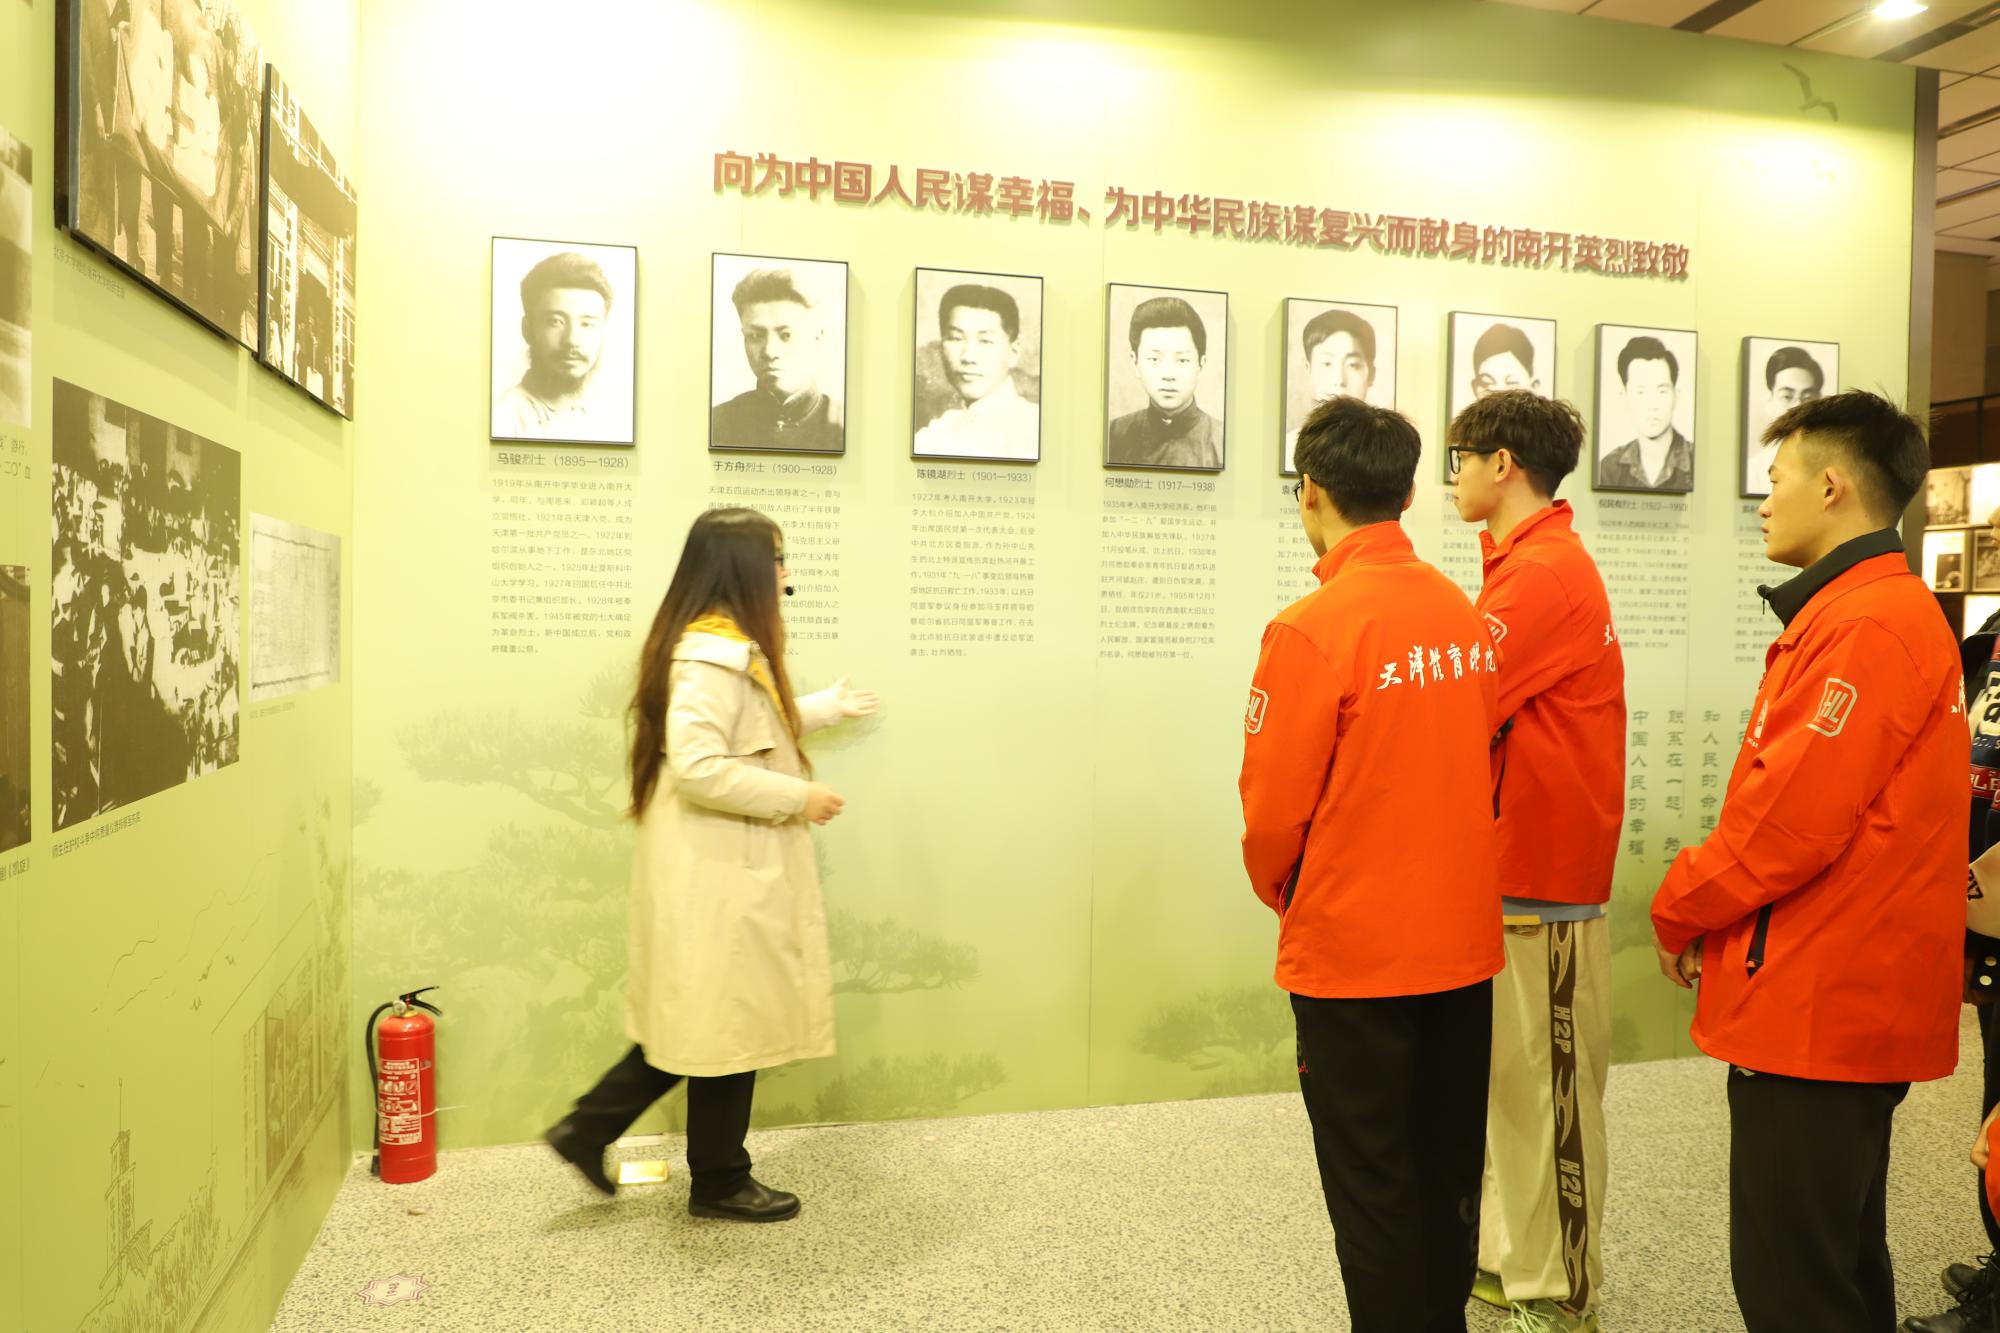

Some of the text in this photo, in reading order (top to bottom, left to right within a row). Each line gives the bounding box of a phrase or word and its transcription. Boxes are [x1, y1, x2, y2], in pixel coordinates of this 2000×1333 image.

[713, 150, 1690, 278] 向为中国人民谋幸福、为中华民族谋复兴而献身的南开英烈致敬
